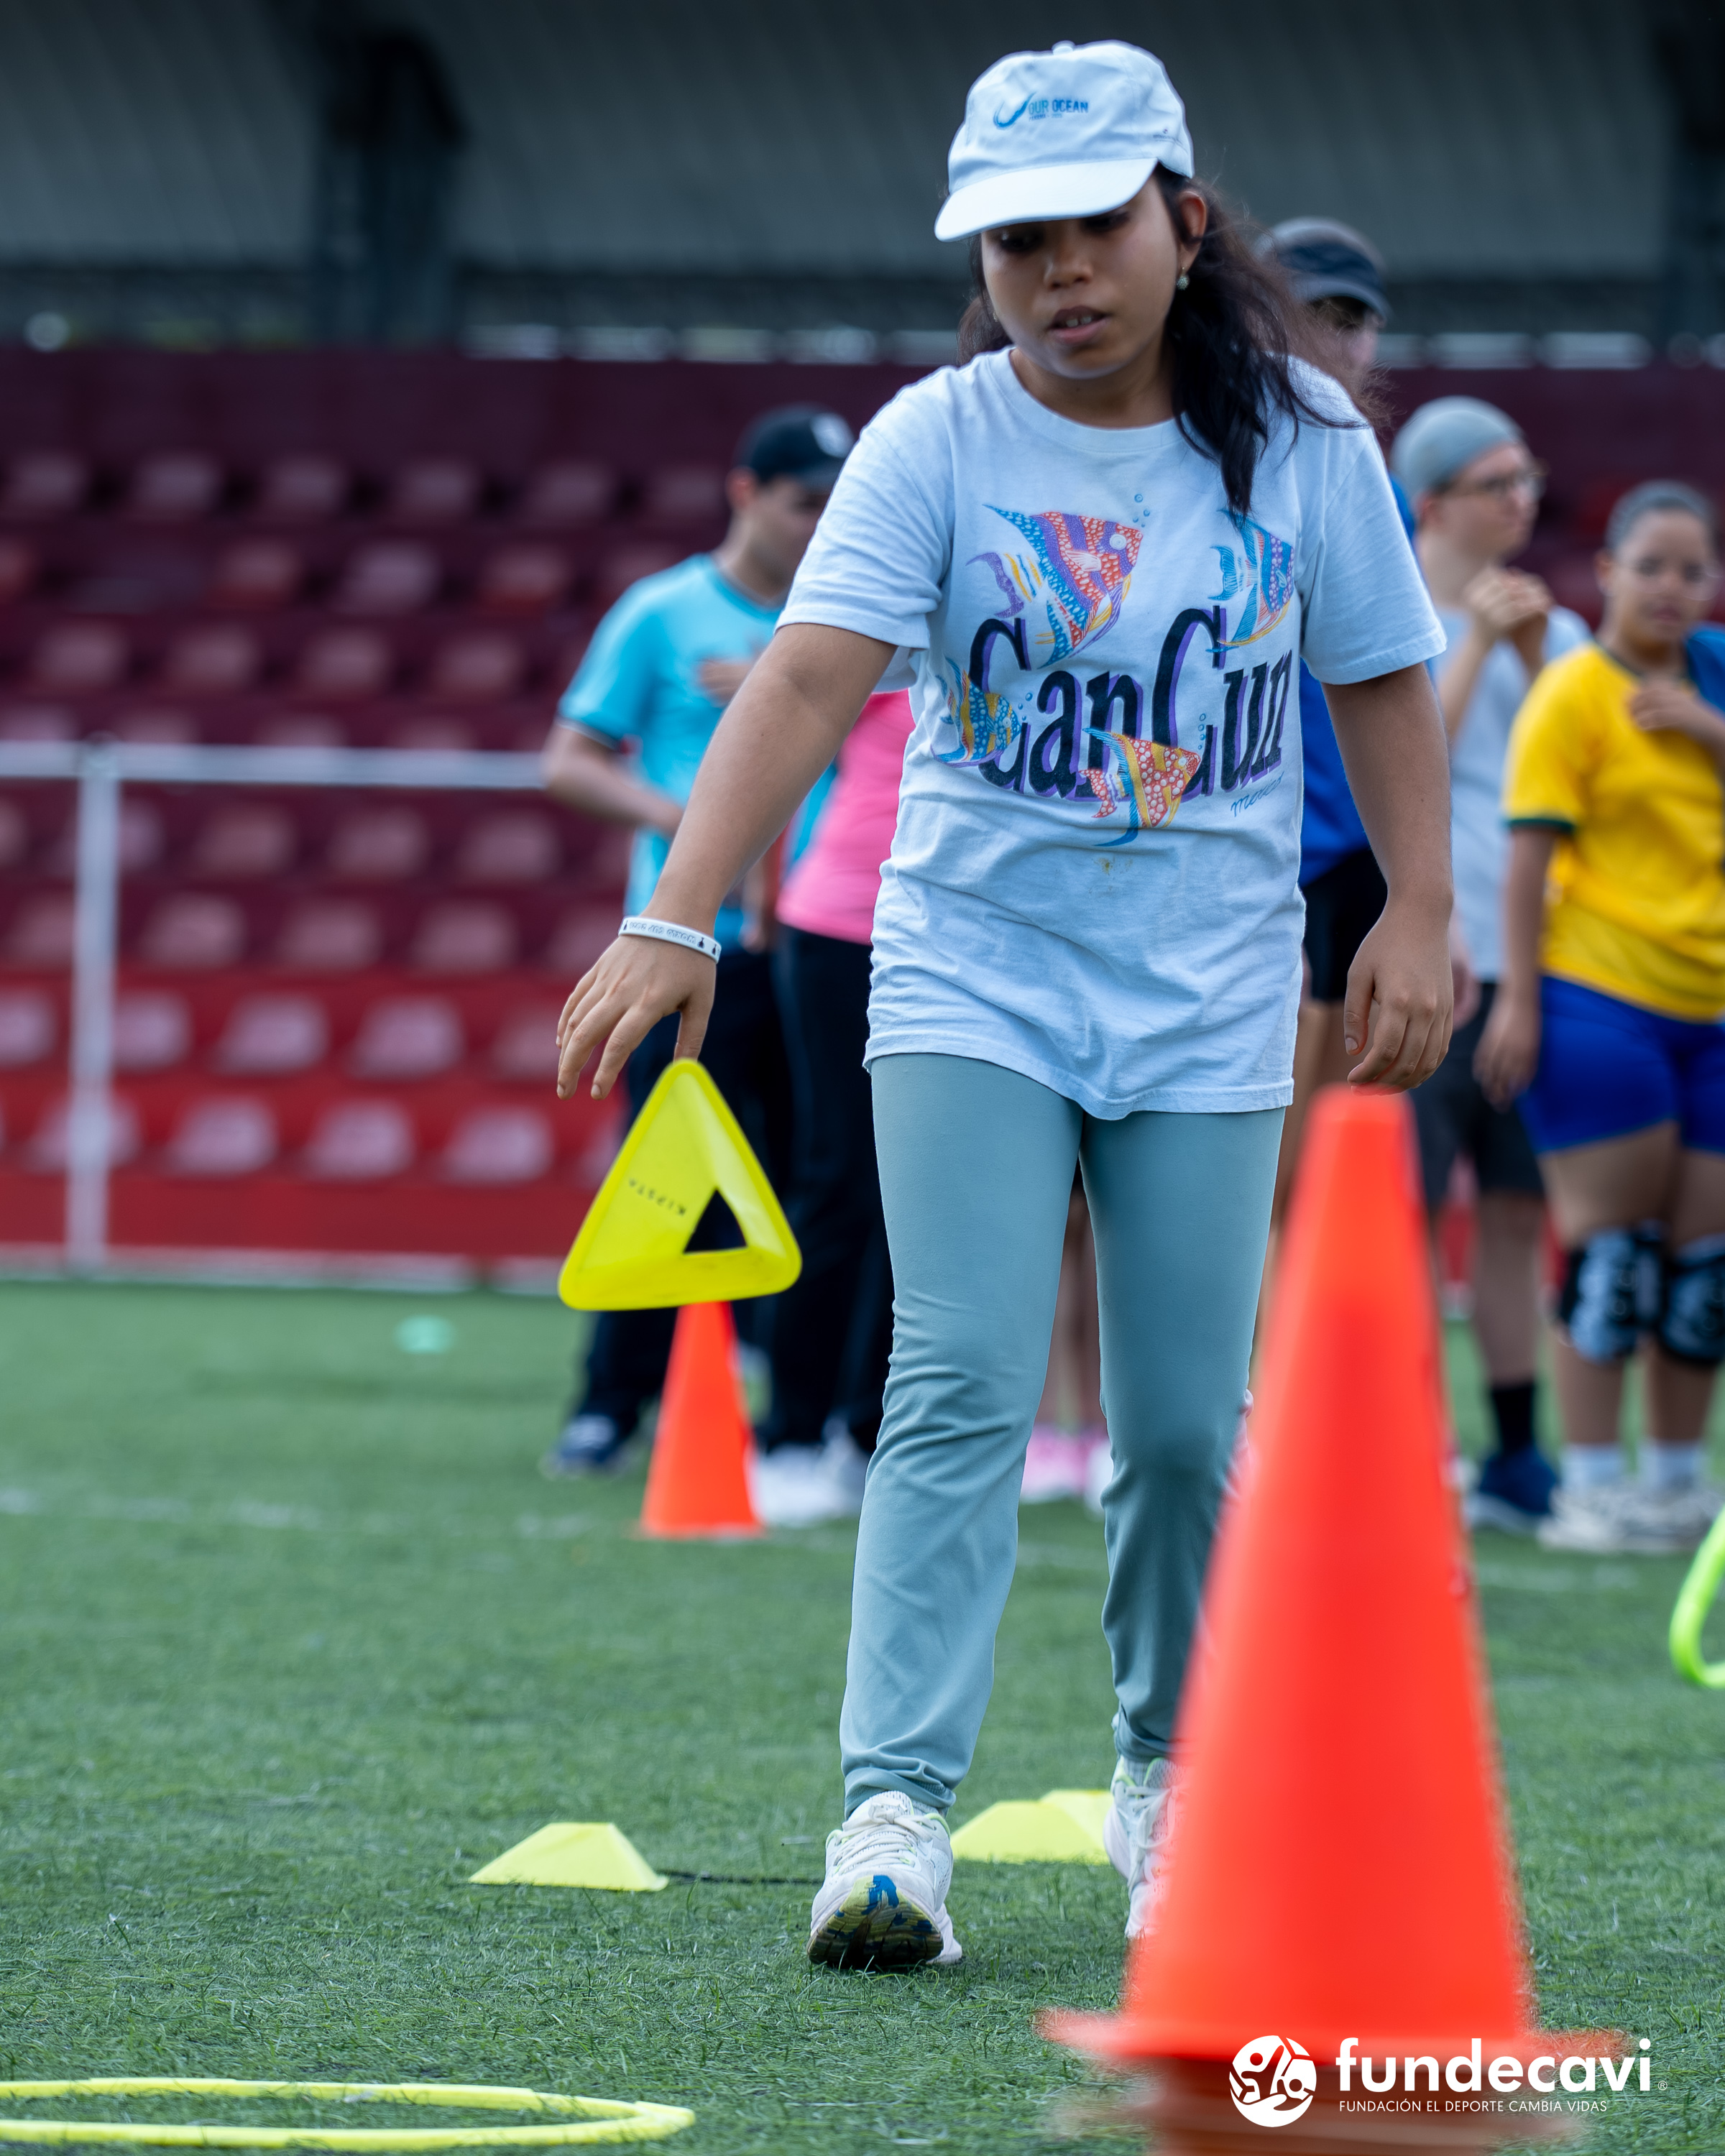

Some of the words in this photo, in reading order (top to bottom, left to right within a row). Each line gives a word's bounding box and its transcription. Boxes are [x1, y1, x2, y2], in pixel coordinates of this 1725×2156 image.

[1029, 100, 1049, 115] OUR
[1052, 99, 1089, 114] OCEAN
[647, 924, 665, 935] CUP
[666, 929, 696, 945] WORLD
